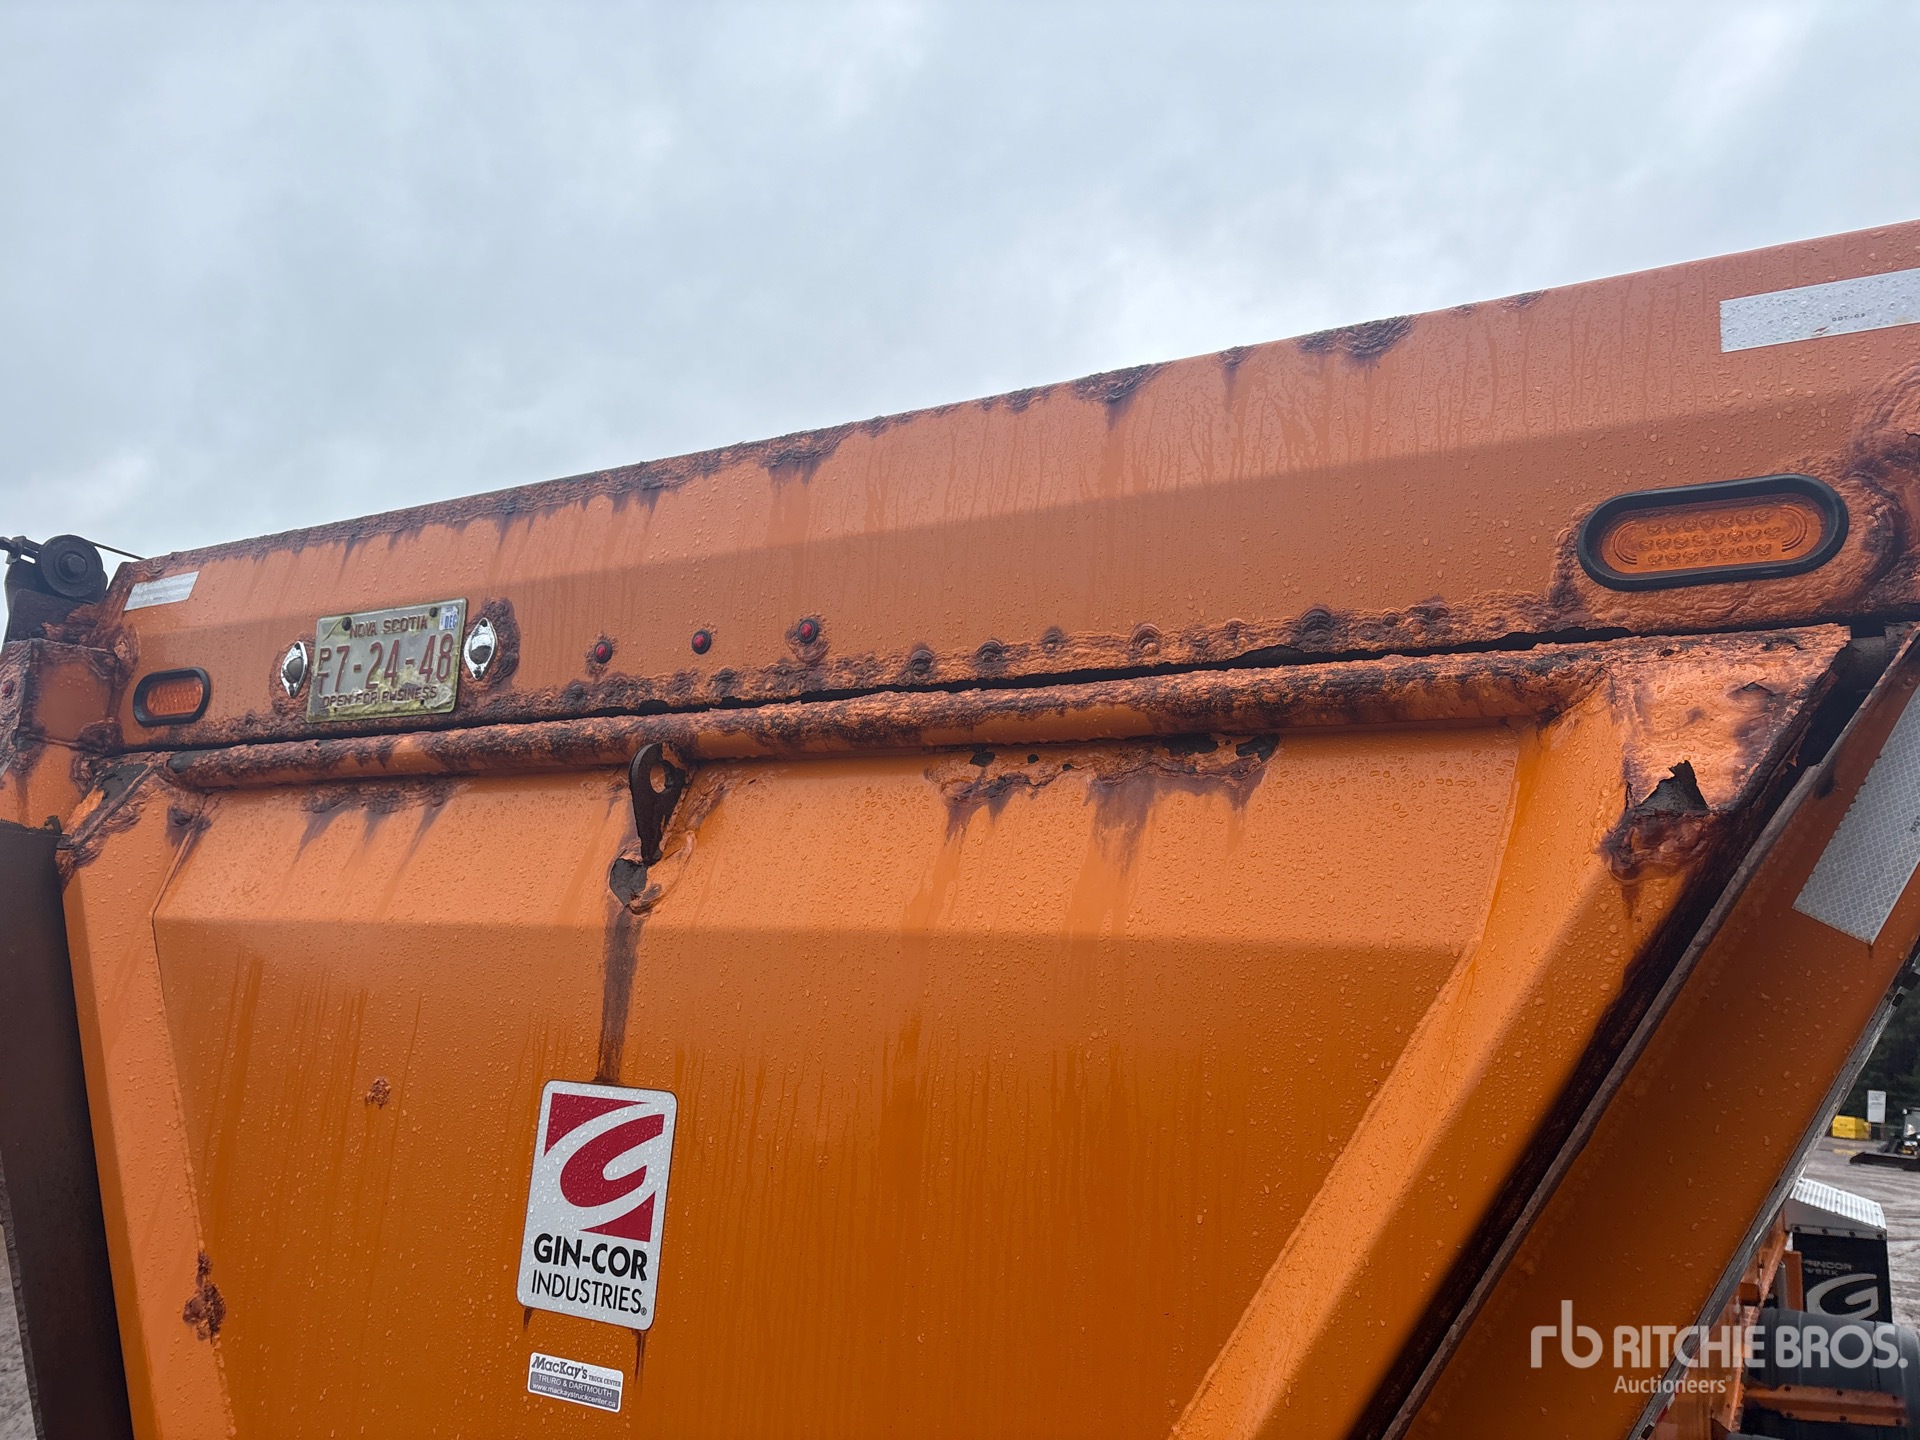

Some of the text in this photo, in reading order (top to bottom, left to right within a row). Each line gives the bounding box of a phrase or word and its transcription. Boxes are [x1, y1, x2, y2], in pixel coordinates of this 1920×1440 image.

[349, 619, 377, 638] NOVA
[383, 615, 428, 633] SCOTIA
[322, 685, 438, 708] OPEN FOR BUSINESS
[533, 1232, 648, 1282] GIN-COR
[531, 1356, 621, 1387] MacKay's TRUCK CENTER
[532, 1383, 615, 1407] www.mackaystruckcenter.ca
[537, 1374, 613, 1398] TRURO & DARTMOUTH
